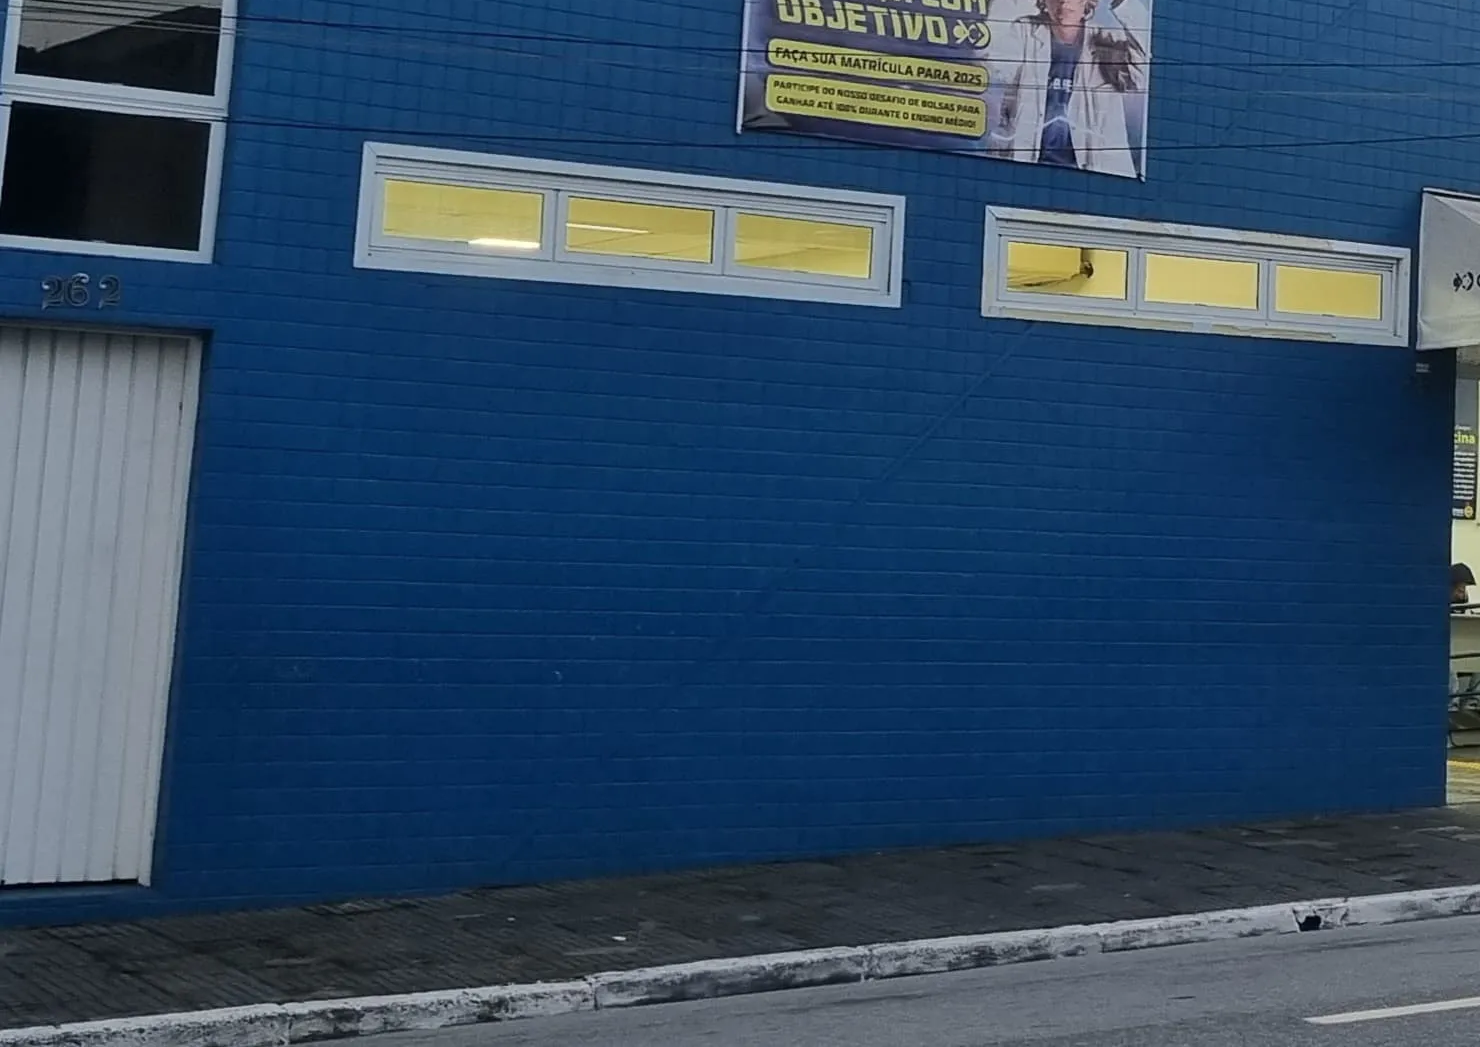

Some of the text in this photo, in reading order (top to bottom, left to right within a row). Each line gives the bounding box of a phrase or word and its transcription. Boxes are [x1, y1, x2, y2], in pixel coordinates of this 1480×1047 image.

[775, 47, 982, 86] FAÇA SUA MATRÍCULA PARA 2025
[774, 81, 980, 114] PARTICIPE DO NOSSO DESAFIO DE BOLSAS PARA
[776, 96, 815, 108] GANHAR
[817, 100, 833, 111] ATÉ
[859, 106, 900, 119] DURANTE
[911, 112, 943, 125] ENSINO
[41, 273, 121, 310] 262
